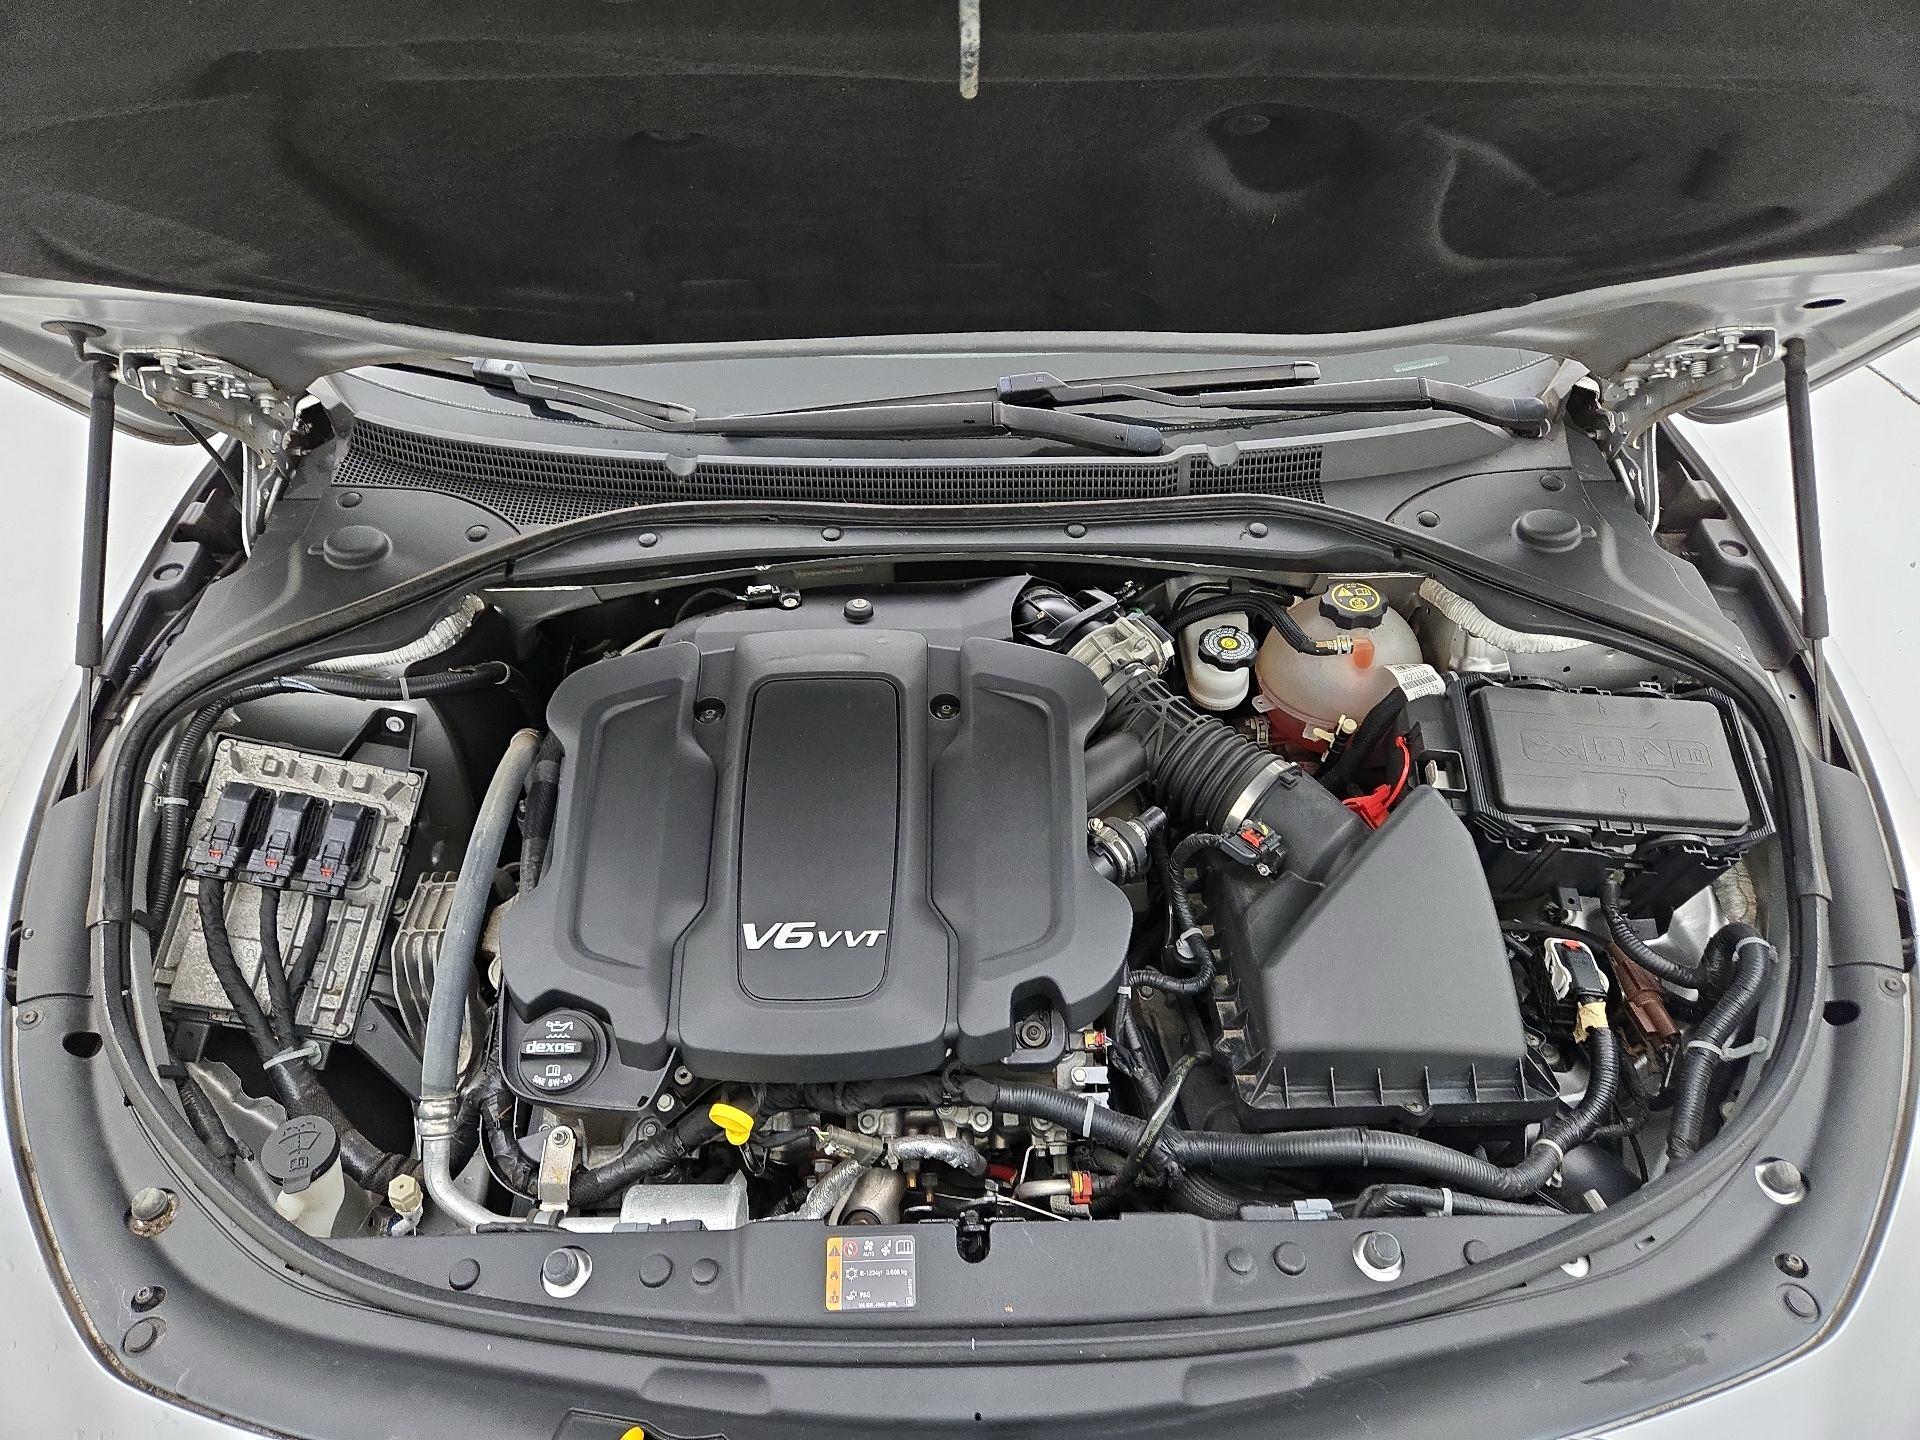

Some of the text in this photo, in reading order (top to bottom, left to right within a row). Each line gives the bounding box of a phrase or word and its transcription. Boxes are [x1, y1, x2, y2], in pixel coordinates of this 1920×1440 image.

[742, 921, 886, 950] V6 VVT
[526, 1040, 576, 1053] dexos
[532, 1074, 546, 1086] SAE
